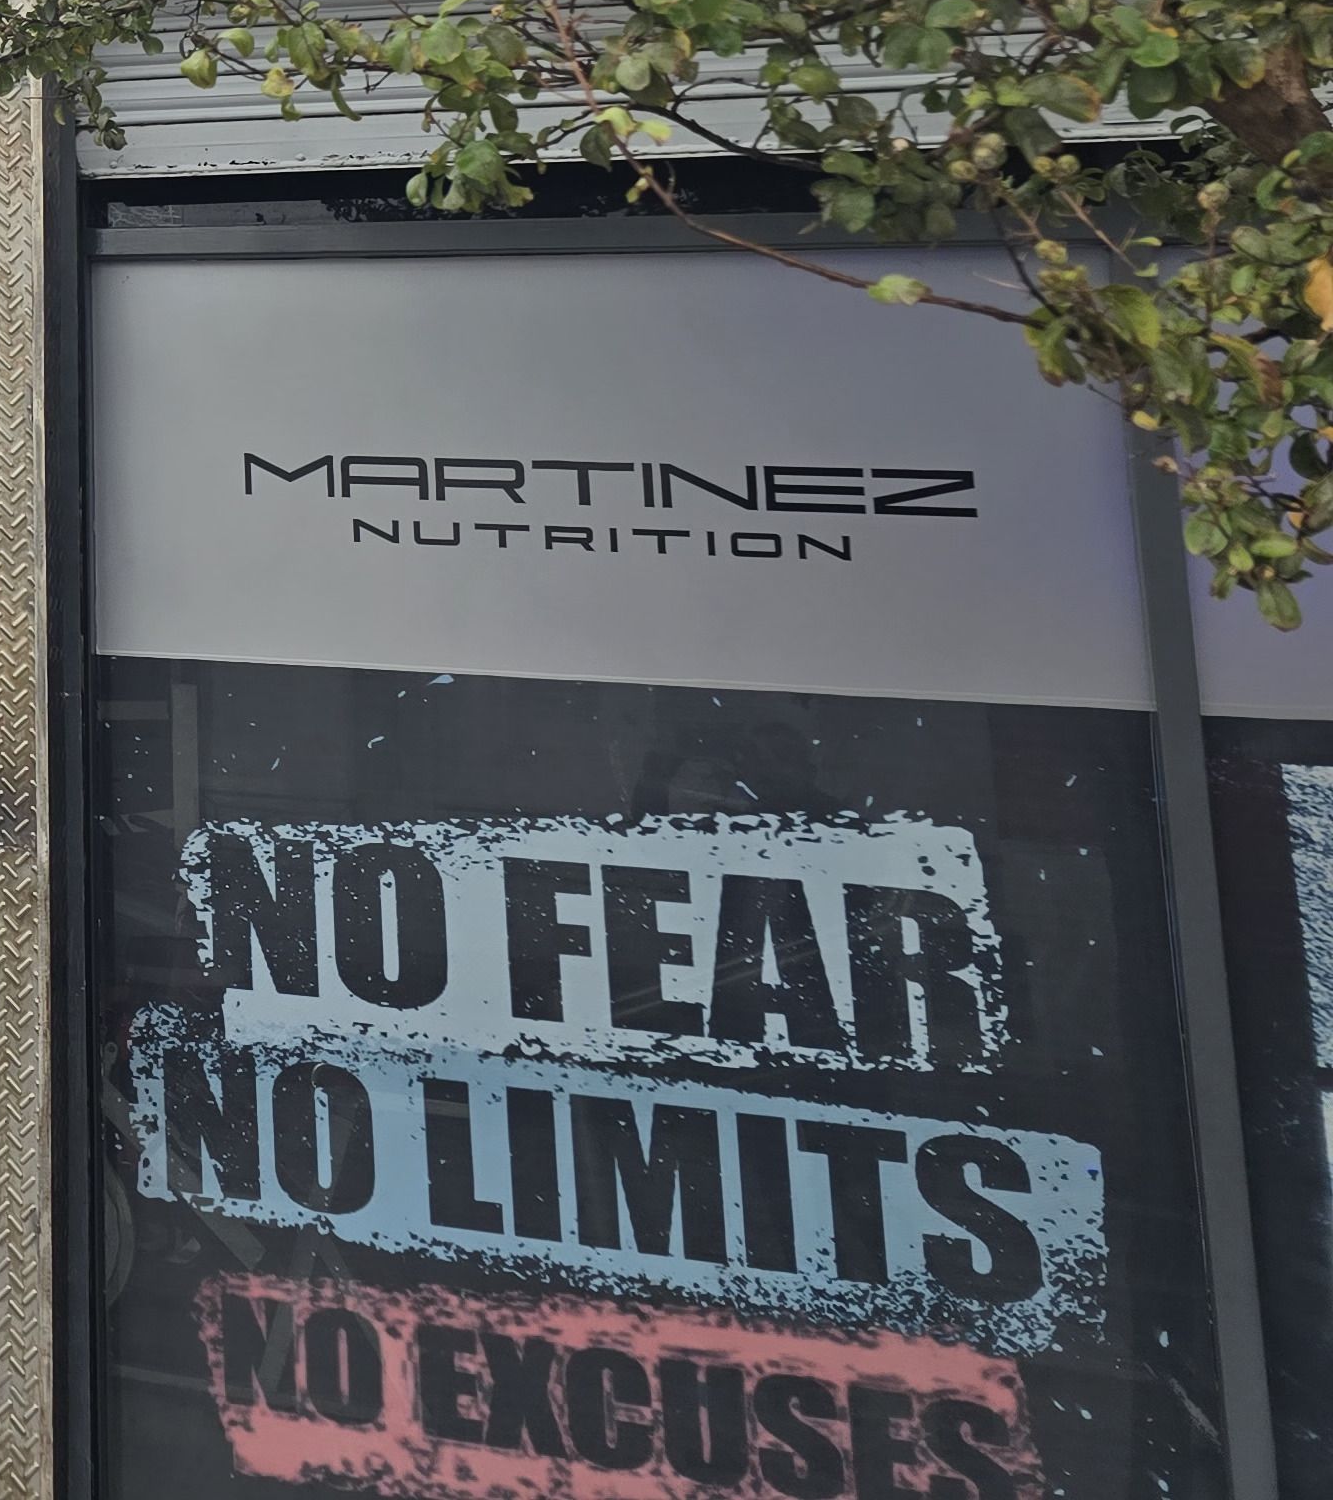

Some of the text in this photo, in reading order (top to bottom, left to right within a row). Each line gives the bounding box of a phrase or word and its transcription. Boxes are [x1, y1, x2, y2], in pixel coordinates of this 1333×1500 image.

[244, 452, 978, 519] MARTINEZ
[351, 518, 852, 562] NUTRITION
[205, 833, 986, 1061] NO FEAR
[162, 1046, 1046, 1303] NO LIMITS
[221, 1295, 1015, 1500] NO EXCUSES
